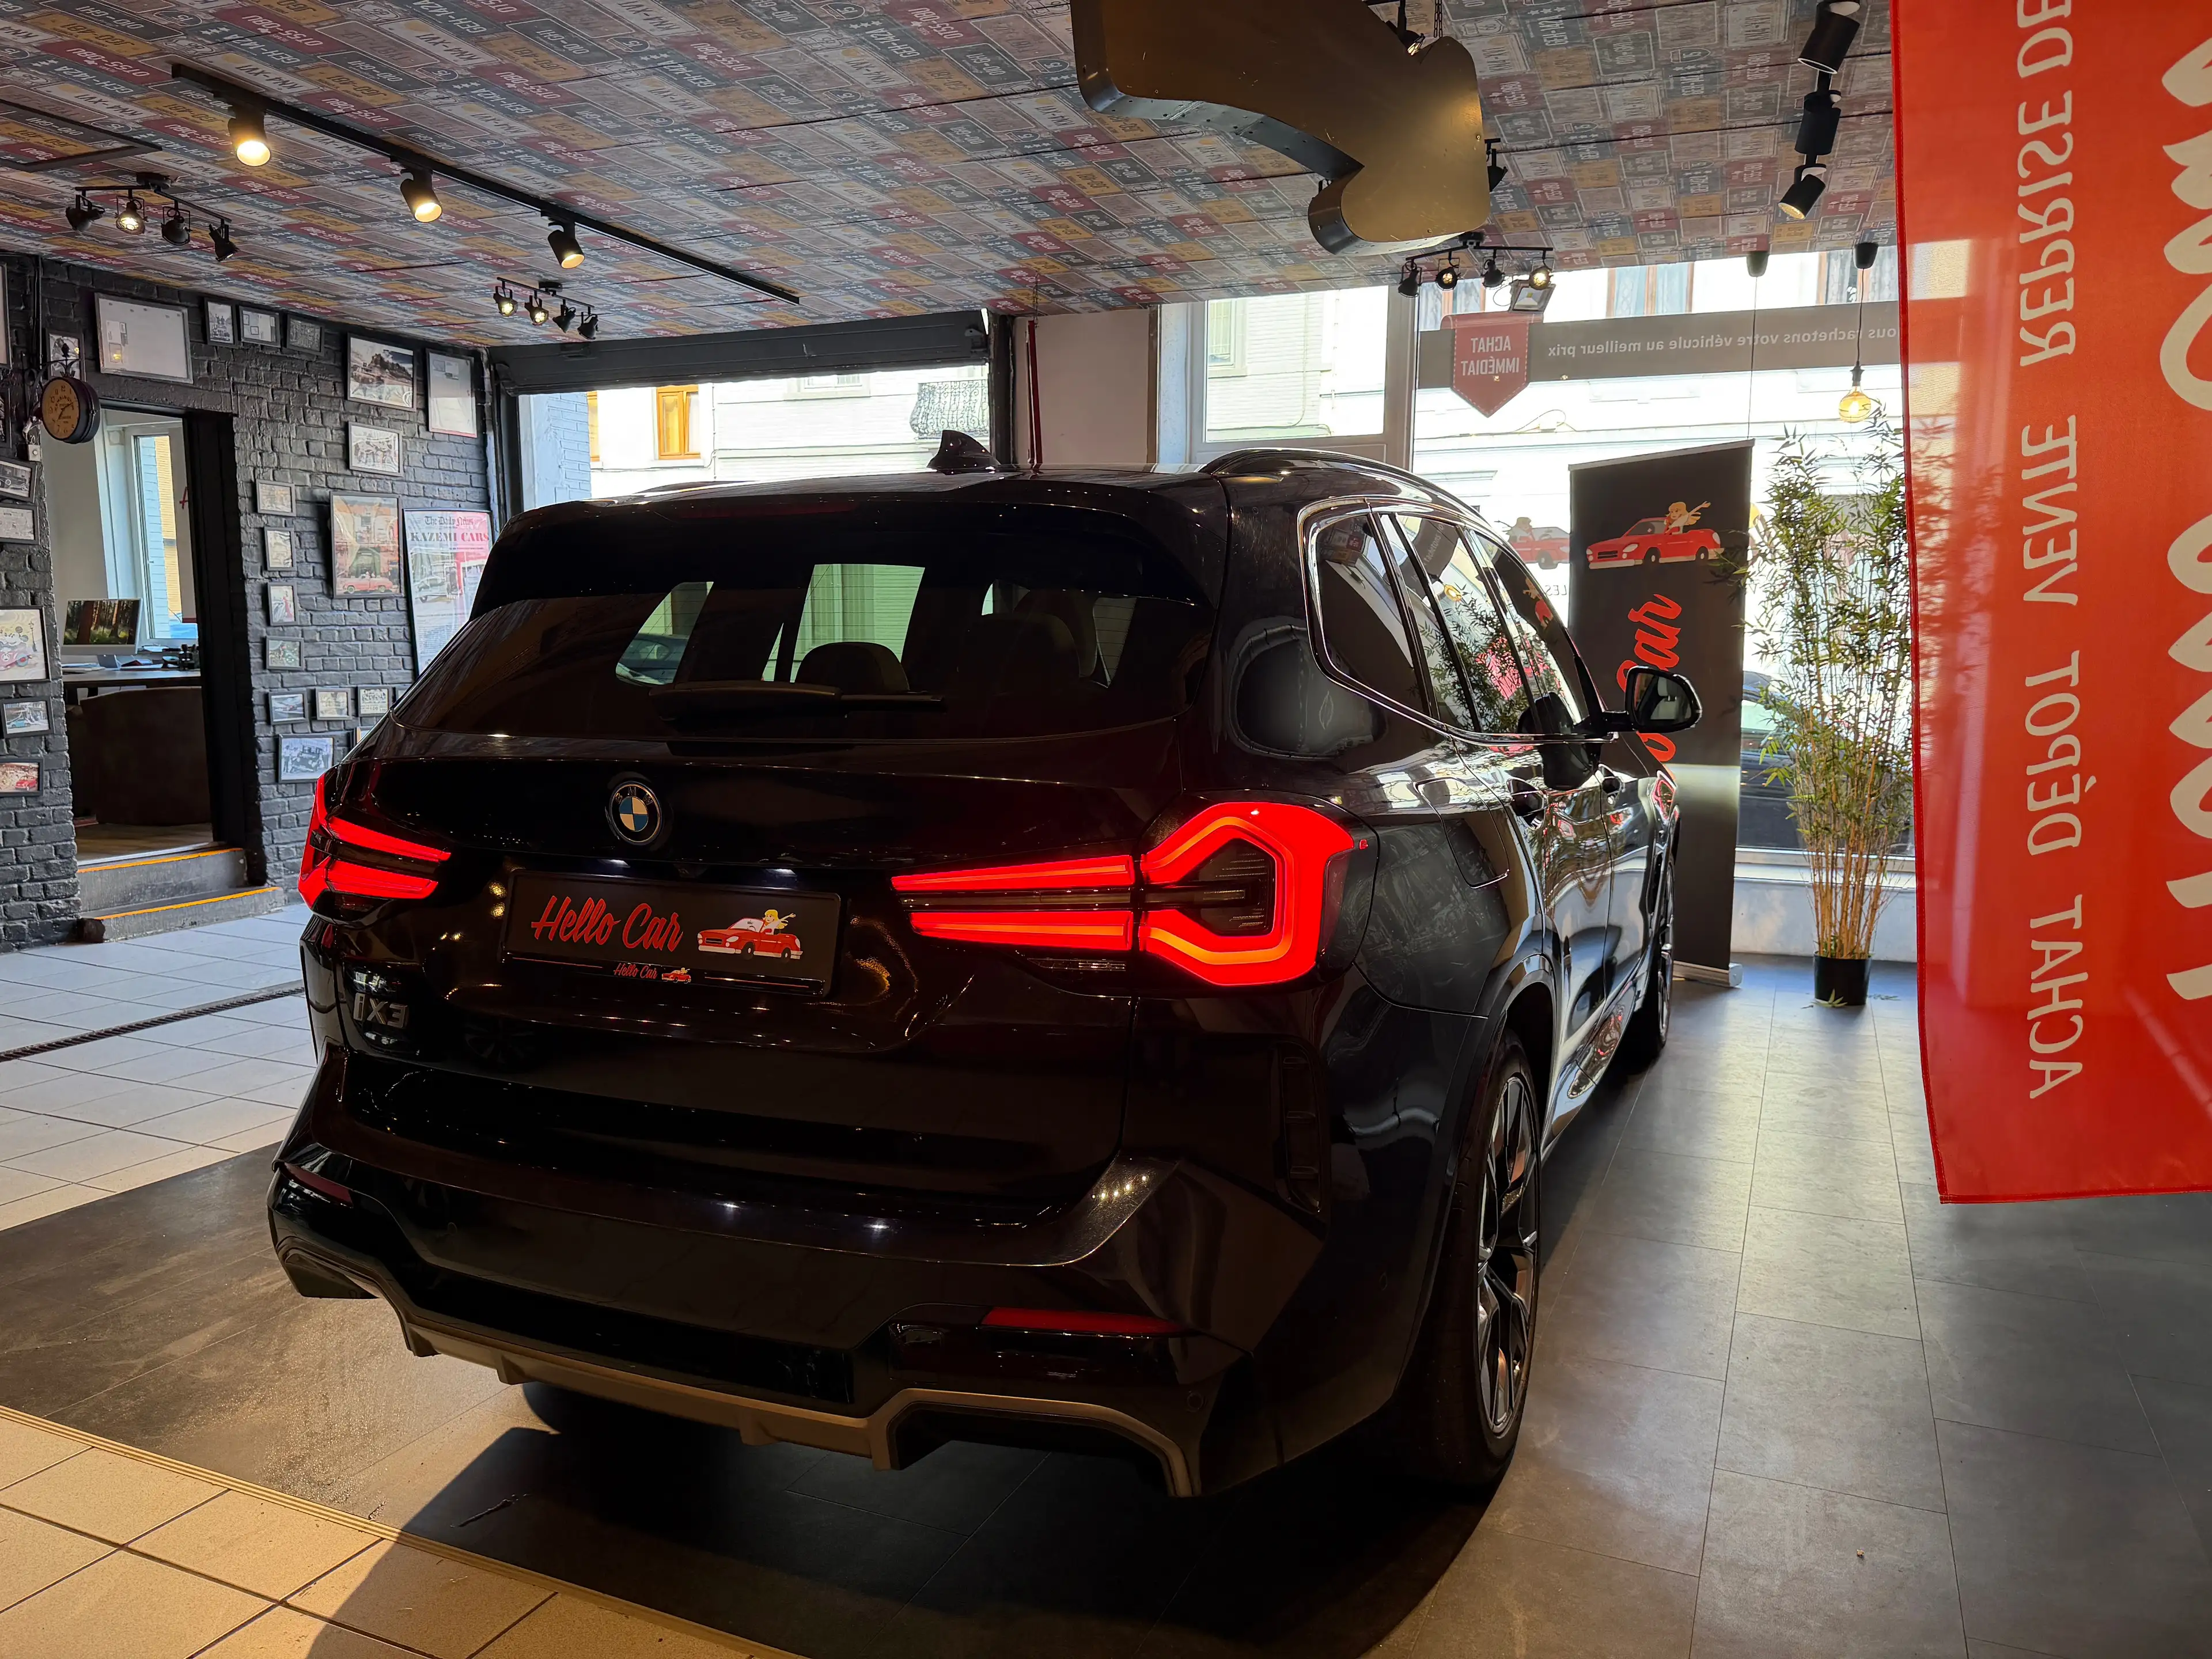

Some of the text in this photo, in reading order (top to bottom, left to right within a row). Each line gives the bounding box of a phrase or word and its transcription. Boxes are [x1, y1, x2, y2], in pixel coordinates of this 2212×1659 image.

[408, 0, 490, 33] GEH-142A
[862, 26, 922, 59] GEH-142A
[1536, 13, 1568, 47] GEH-142A
[218, 32, 304, 64] GEH-142A
[49, 65, 137, 93] GEH-142A
[654, 59, 719, 88] GEH-142A
[467, 88, 536, 114] GEH-142A
[859, 107, 911, 132] GEH-142A
[146, 138, 220, 160] GEH-142A
[677, 131, 733, 154] GEH-142A
[511, 153, 570, 174] GEH-142A
[857, 169, 903, 188] GEH-142A
[424, 516, 474, 527] The Daily News
[410, 532, 489, 542] KAZEMI CARS
[615, 786, 653, 805] BMW
[531, 895, 684, 953] Hello Car
[613, 962, 658, 980] Hello Car
